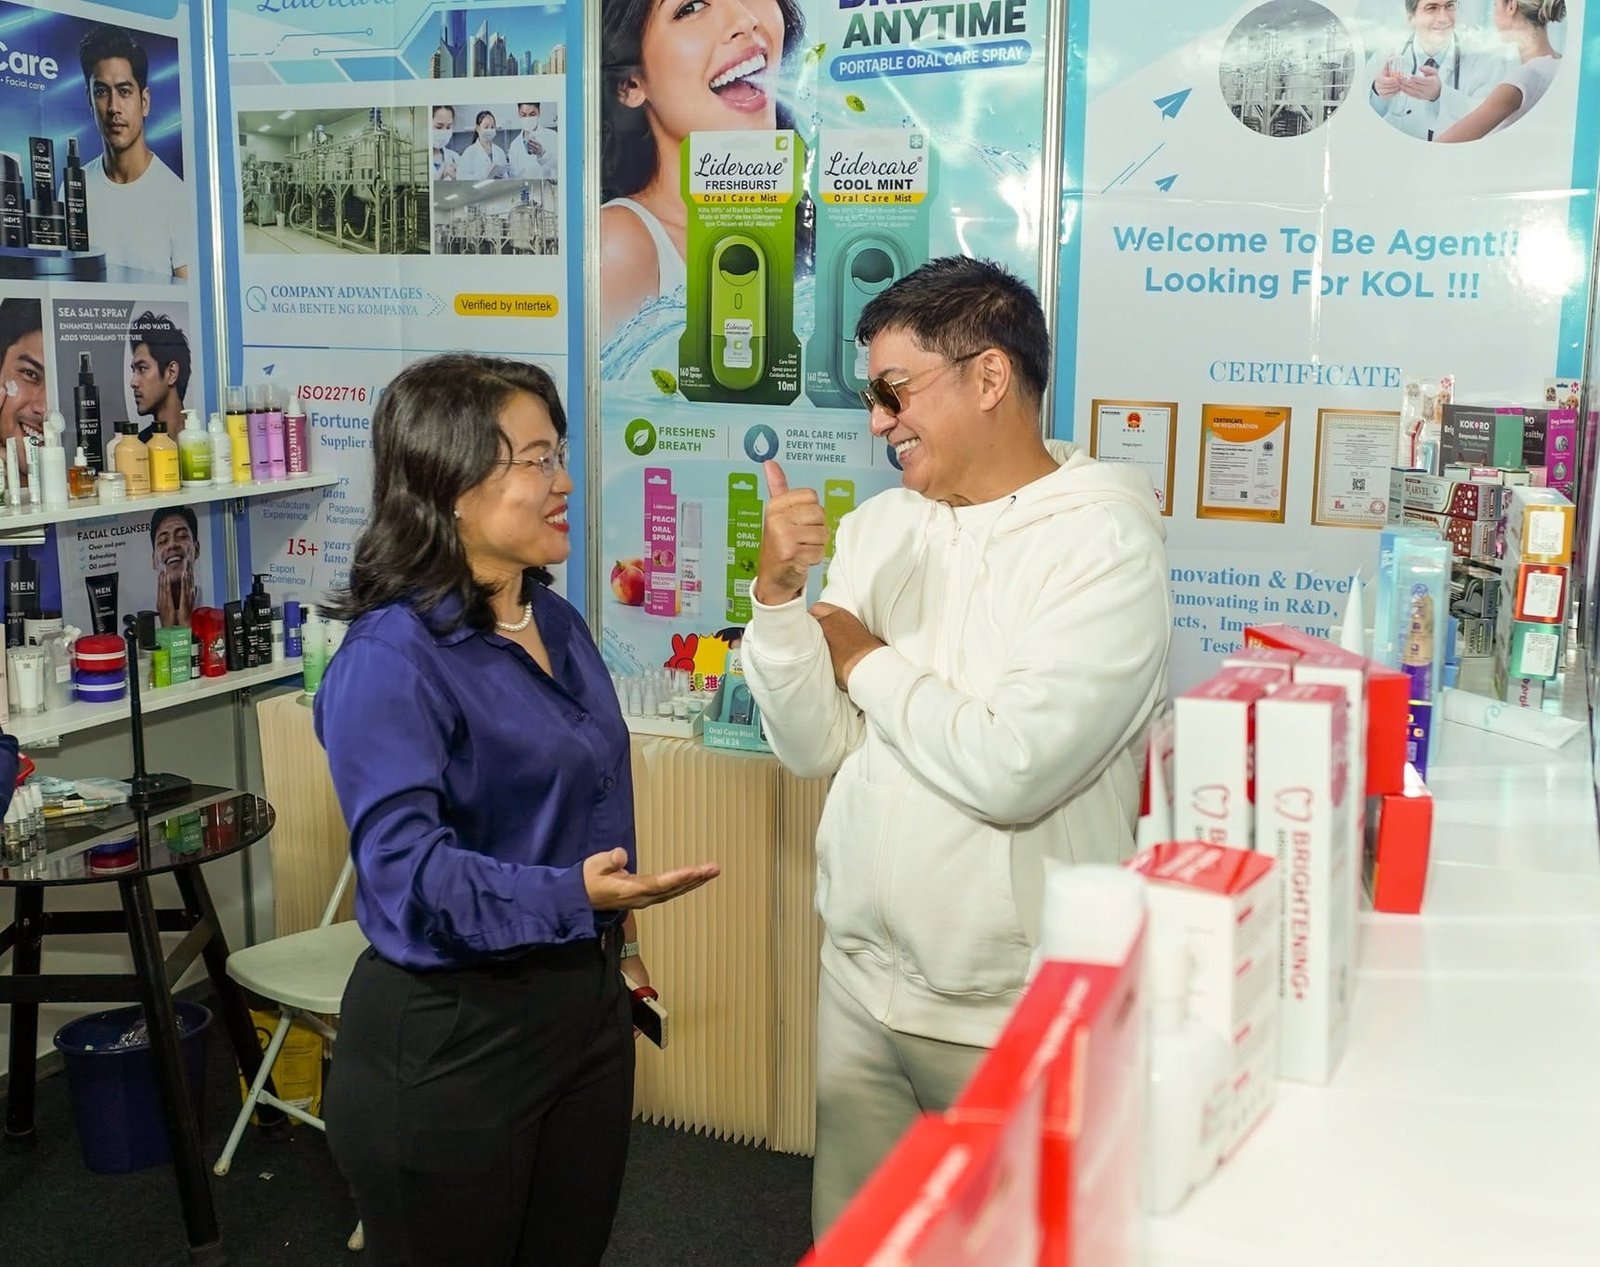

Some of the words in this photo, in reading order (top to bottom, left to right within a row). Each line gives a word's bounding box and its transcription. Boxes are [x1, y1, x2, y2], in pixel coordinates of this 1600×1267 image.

[843, 2, 1027, 49] ANYTIME
[839, 56, 903, 76] PORTABLE
[906, 53, 942, 69] ORAL
[944, 50, 979, 66] CARE
[982, 46, 1024, 63] SPRAY
[6, 76, 28, 88] Facial
[29, 82, 46, 91] care
[705, 180, 778, 190] FRESHBURST
[833, 179, 873, 190] COOL
[877, 179, 913, 190] MINT
[704, 194, 727, 203] Oral
[731, 194, 755, 203] Care
[760, 194, 777, 203] Mist
[834, 194, 858, 203] Oral
[863, 194, 889, 203] Care
[894, 194, 912, 203] Mist
[1113, 226, 1268, 253] Welcome
[1279, 228, 1319, 254] To
[1331, 228, 1375, 255] Be
[1145, 267, 1279, 300] Looking
[1292, 269, 1350, 296] For
[1362, 270, 1434, 298] KOL
[1447, 272, 1480, 299] !!!
[270, 285, 336, 298] COMPANY
[337, 286, 423, 299] ADVANTAGES
[272, 303, 297, 313] MGA
[299, 303, 336, 314] BENTE
[338, 304, 355, 314] NG
[357, 304, 418, 316] KOMPANYA
[461, 299, 497, 310] Verified
[500, 300, 512, 312] by
[515, 300, 552, 311] Intertek
[58, 308, 76, 317] SEA
[78, 308, 100, 317] SALT
[102, 308, 128, 317] SPRAY
[1209, 360, 1402, 388] CERTIFICATE
[777, 381, 797, 391] 10ml
[297, 385, 366, 402] ISO22716
[311, 412, 370, 430] Fortune
[658, 427, 716, 438] FRESHENS
[786, 429, 810, 438] ORAL
[811, 430, 834, 439] CARE
[836, 431, 858, 441] MIST
[1444, 425, 1455, 436] Brig
[1525, 430, 1544, 440] ealthy
[321, 435, 366, 450] Supplier
[658, 440, 702, 452] BREATH
[786, 440, 814, 450] EVERY
[815, 442, 836, 451] TIME
[786, 452, 814, 462] EVERY
[815, 453, 846, 463] WHERE
[261, 498, 310, 510] Manufacture
[328, 502, 365, 514] Paggawa
[263, 509, 308, 520] Experience
[652, 515, 676, 523] PEACH
[77, 529, 109, 541] FACIAL
[110, 523, 151, 536] CLEANSER
[652, 526, 672, 534] ORAL
[736, 532, 757, 540] ORAL
[286, 538, 319, 556] 15+
[323, 540, 351, 552] years
[88, 552, 117, 560] Refreshing
[324, 553, 348, 564] tano
[269, 563, 295, 574] Export
[333, 568, 350, 578] I-ex
[262, 575, 306, 586] Experience
[1170, 567, 1260, 588] novation
[1268, 570, 1286, 589] &
[1295, 572, 1355, 594] Devel
[10, 581, 35, 592] MEN
[95, 586, 111, 596] MEN
[1171, 590, 1258, 613] innovating
[1264, 596, 1279, 612] in
[709, 726, 723, 734] Oral
[724, 728, 738, 736] Care
[739, 730, 754, 738] Mist
[709, 736, 725, 745] 10ml
